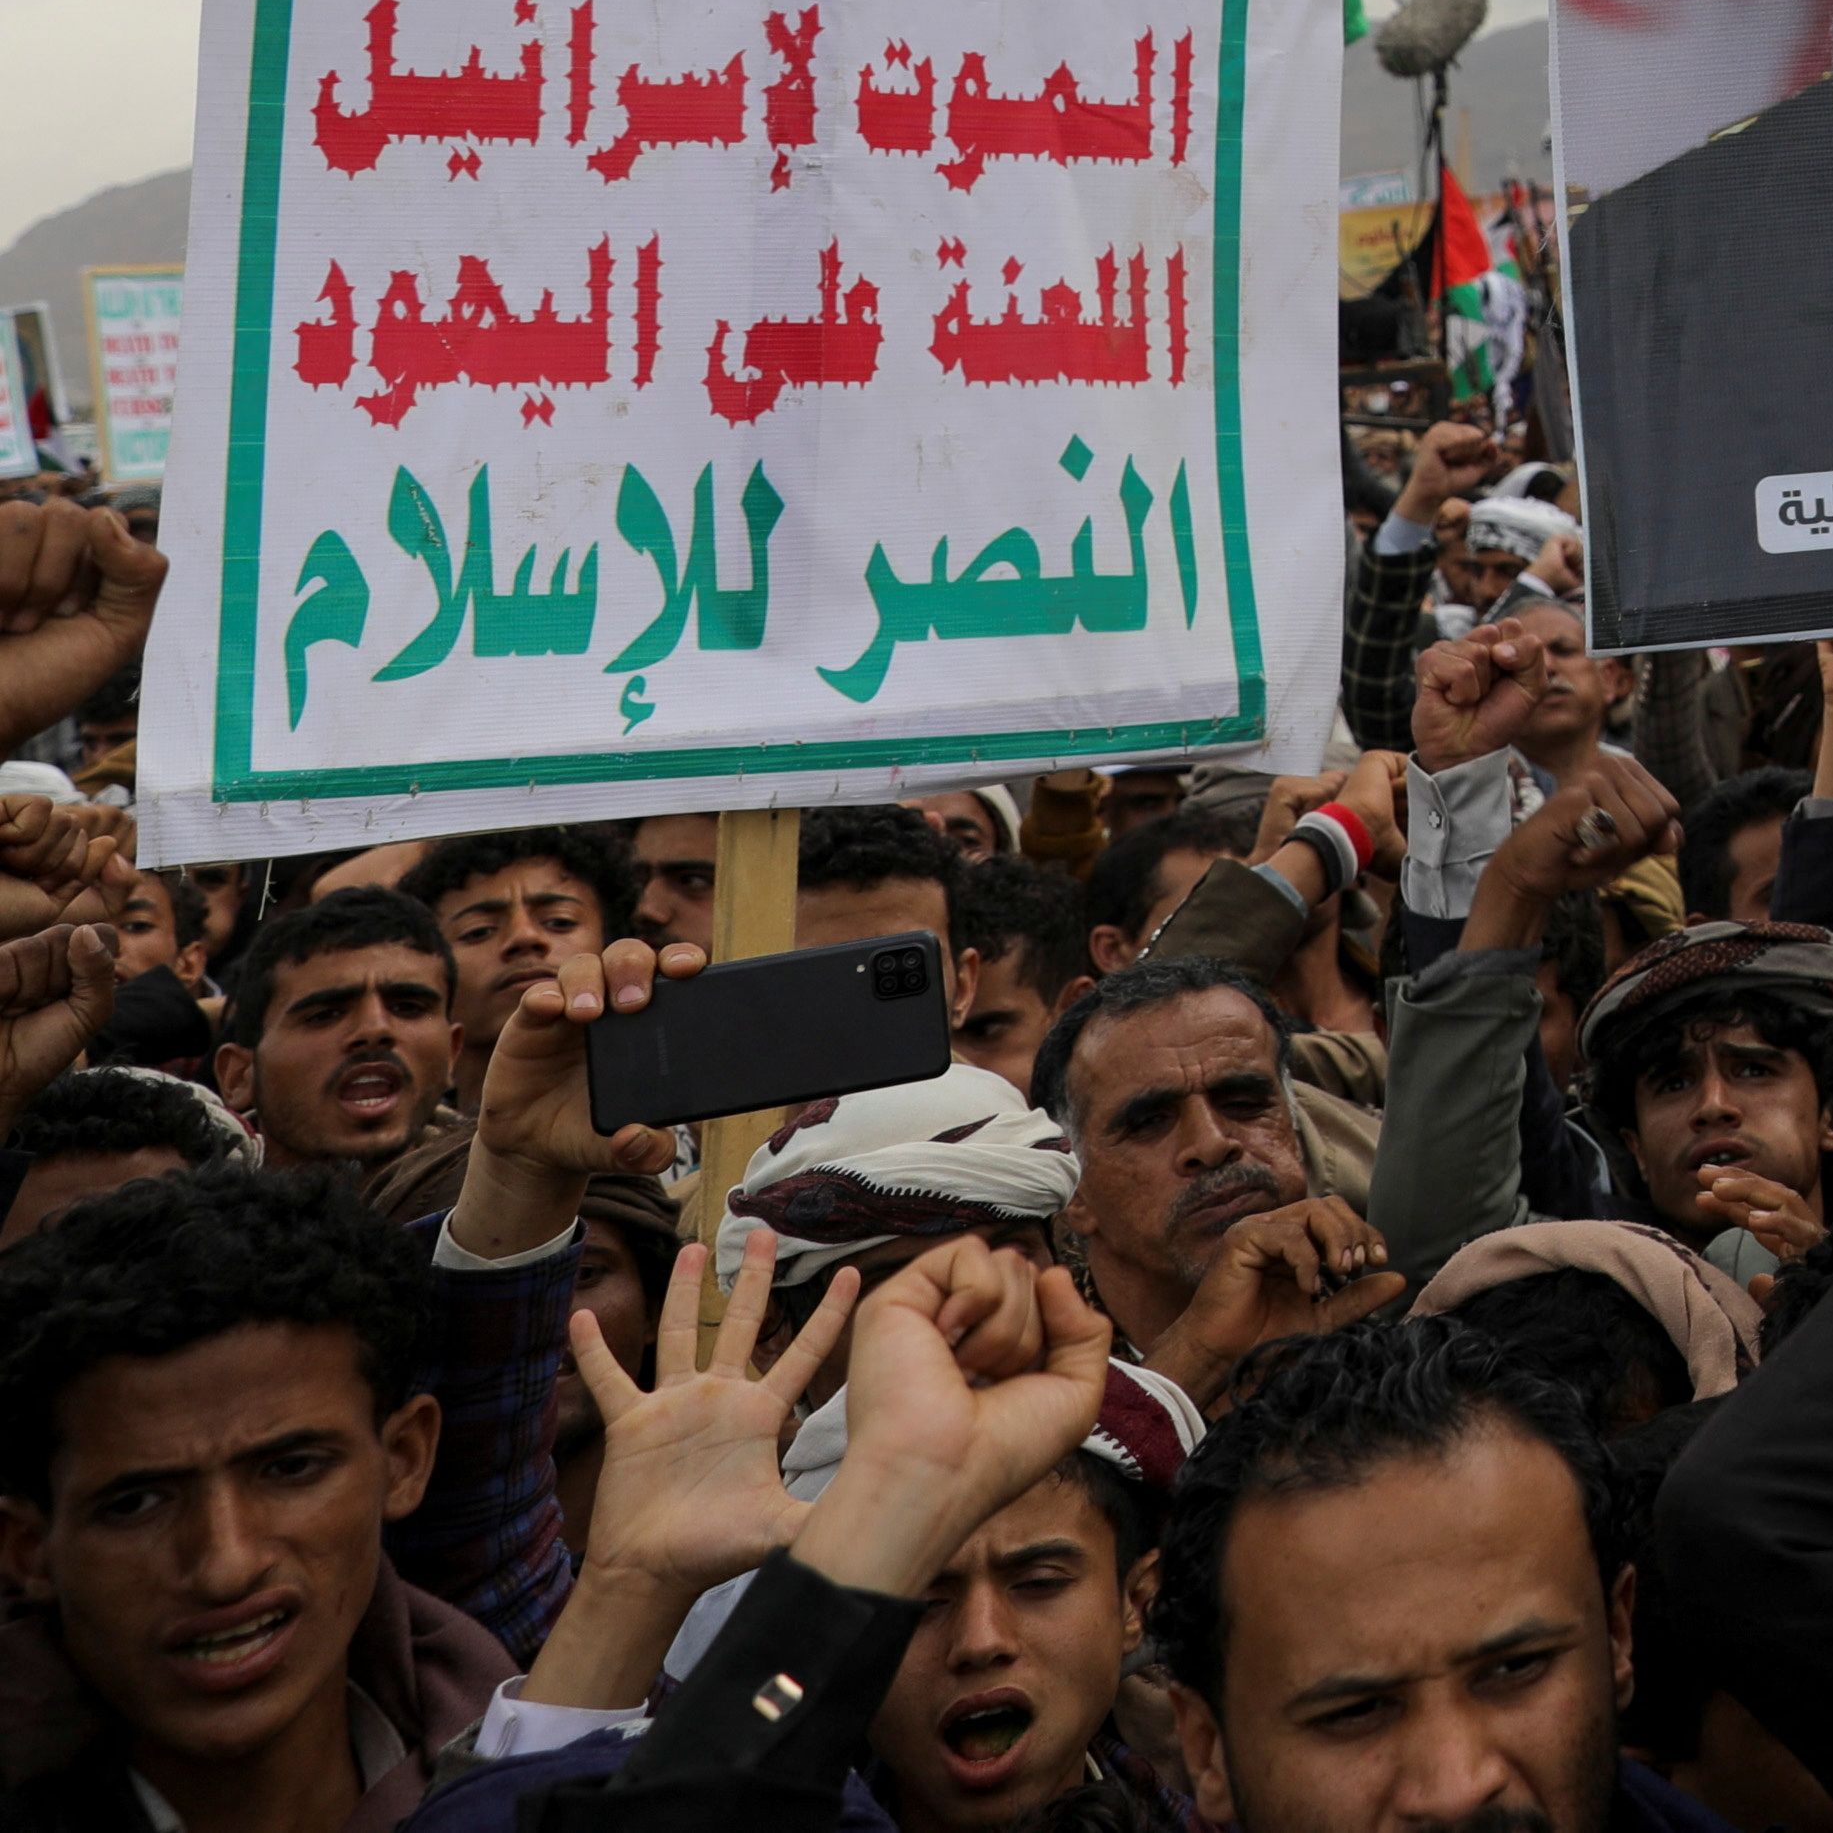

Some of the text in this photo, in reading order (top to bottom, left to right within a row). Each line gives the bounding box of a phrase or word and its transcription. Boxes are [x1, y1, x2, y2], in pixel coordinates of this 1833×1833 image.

[854, 28, 1194, 193] الموت
[293, 233, 1190, 428] اللعنة على اليهود
[284, 435, 1200, 734] النصر للإسلام
